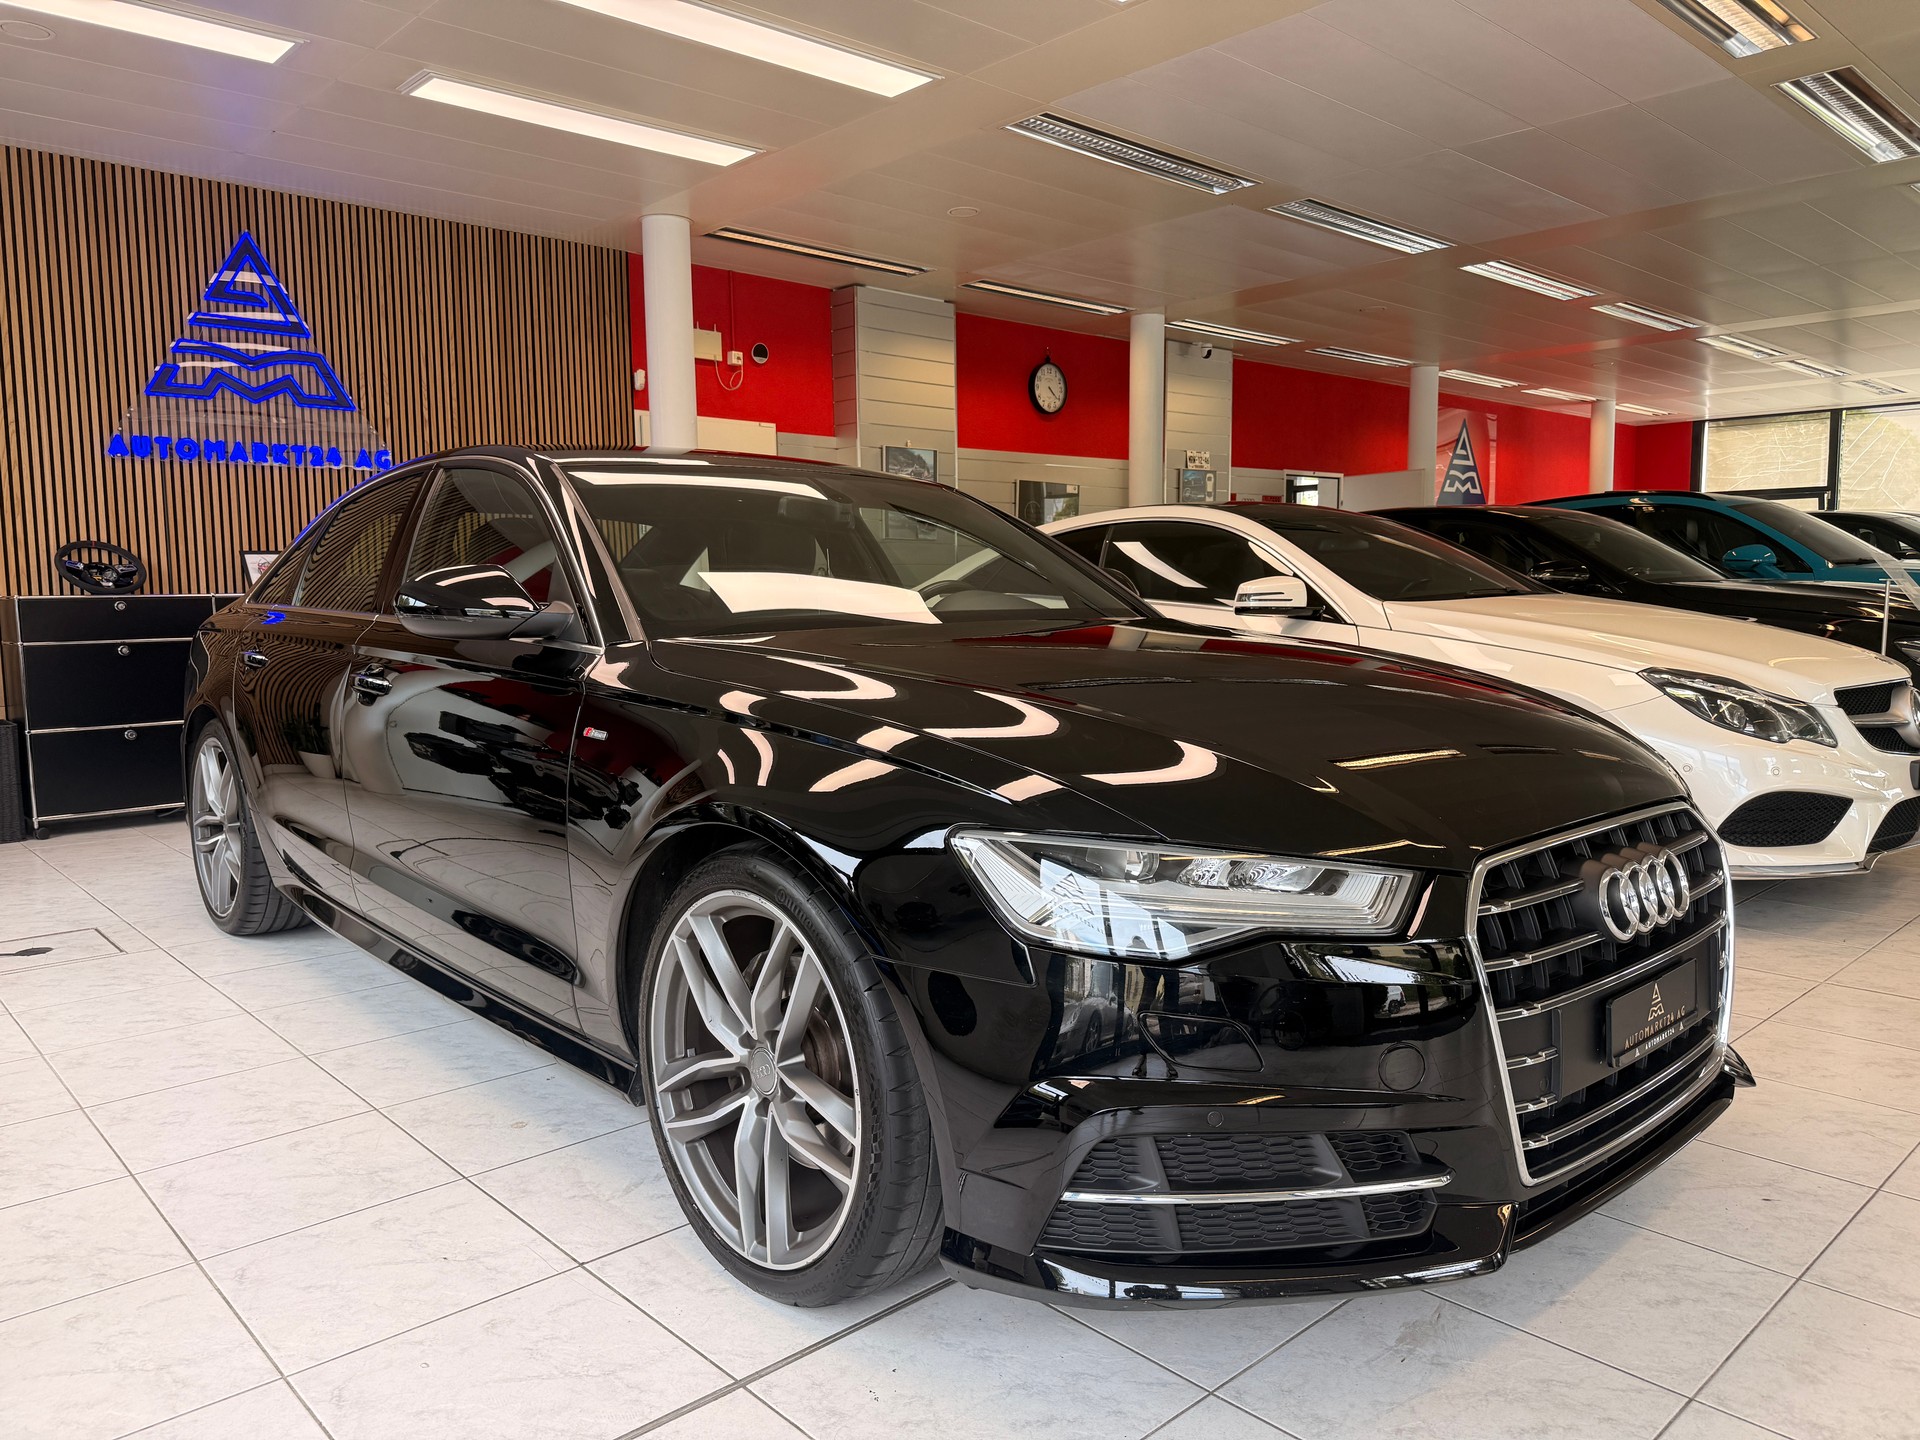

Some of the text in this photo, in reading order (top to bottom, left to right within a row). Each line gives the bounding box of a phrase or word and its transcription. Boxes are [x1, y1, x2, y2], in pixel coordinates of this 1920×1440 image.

[108, 433, 392, 471] AUTOMARKT24 AG
[1624, 1005, 1686, 1050] AUTOMARKT24 AG
